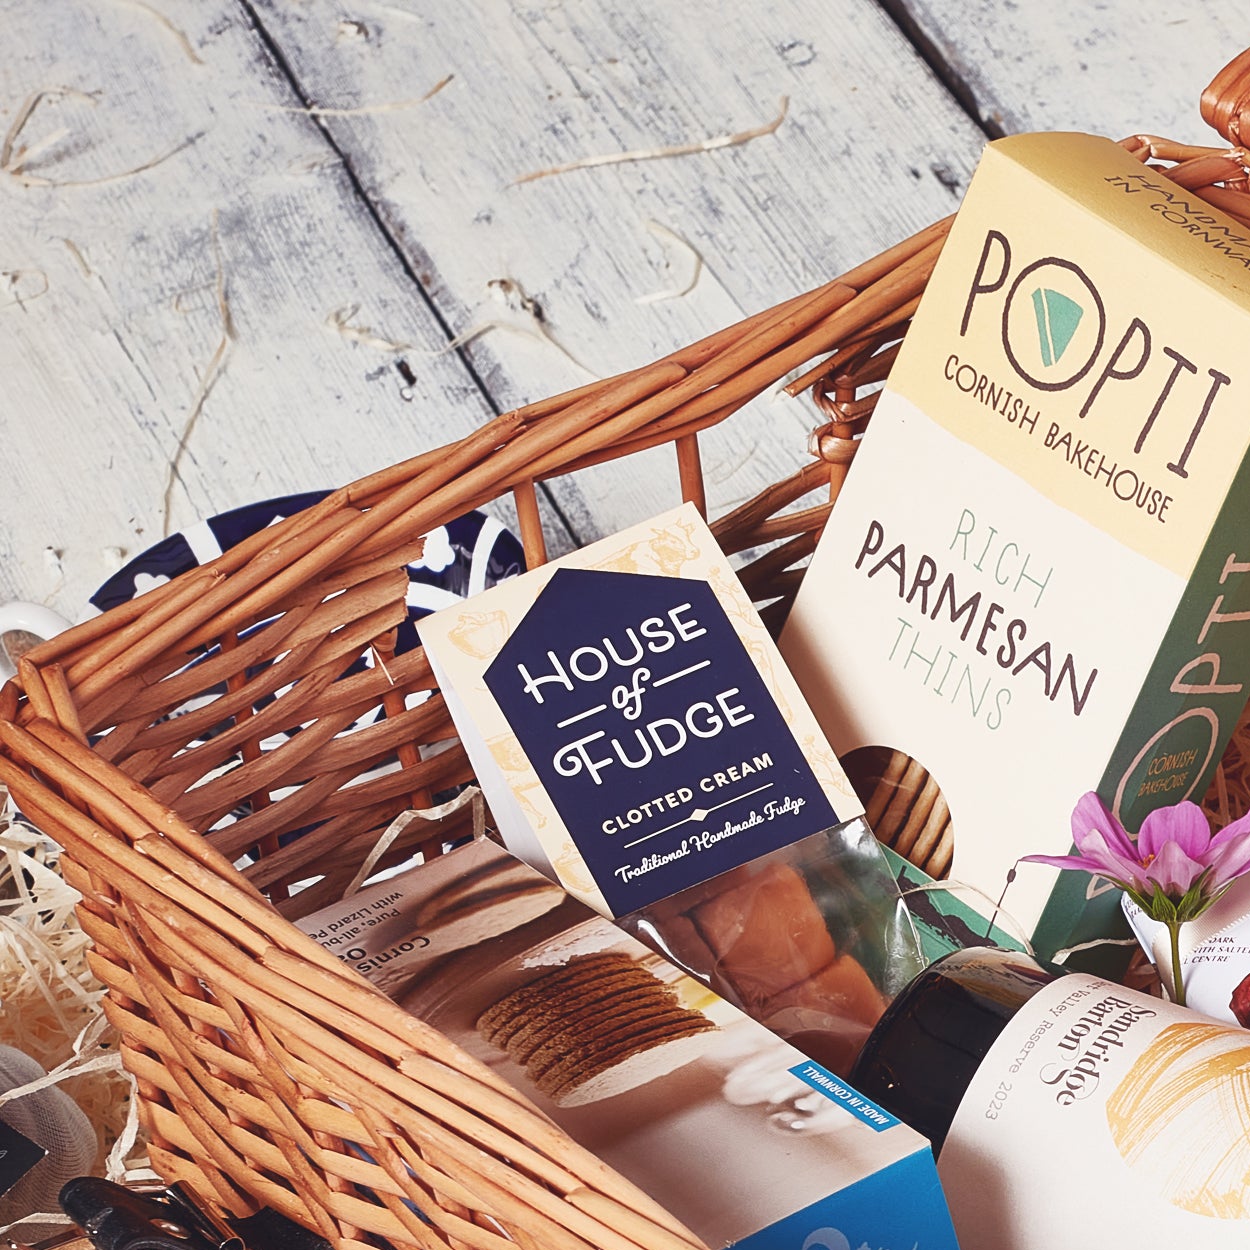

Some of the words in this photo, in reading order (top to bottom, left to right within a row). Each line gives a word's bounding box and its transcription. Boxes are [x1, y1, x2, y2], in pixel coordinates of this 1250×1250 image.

[1104, 176, 1140, 194] IN
[959, 229, 1232, 479] POPTI
[944, 354, 1040, 435] CORNISH
[1044, 422, 1174, 524] BAKEHOUSE
[949, 508, 1053, 608] RICH
[854, 519, 1098, 717] PARMESAN
[517, 602, 707, 705] HOUSE
[888, 616, 1012, 731] THINS
[611, 667, 652, 720] of
[552, 687, 755, 786] FUDGE
[1148, 749, 1199, 776] CORNISH
[601, 787, 694, 835] CLOTTED
[699, 752, 774, 794] CREAM
[1138, 771, 1189, 797] BAKEHOUSE
[614, 839, 691, 884] Traditional
[689, 811, 765, 853] Handmade
[763, 795, 806, 822] Fudge
[327, 907, 372, 933] Lizard
[361, 908, 402, 927] Pure,
[371, 892, 404, 909] with
[1191, 955, 1231, 964] CENTRE
[1050, 990, 1090, 1017] Valley
[1057, 996, 1132, 1062] Barton
[1010, 1019, 1055, 1074] Reserve
[1039, 1004, 1157, 1106] Sandridge
[802, 1066, 853, 1101] CORNWALL
[849, 1096, 861, 1108] IN
[985, 1081, 1013, 1121] 2023
[857, 1102, 890, 1125] MADE
